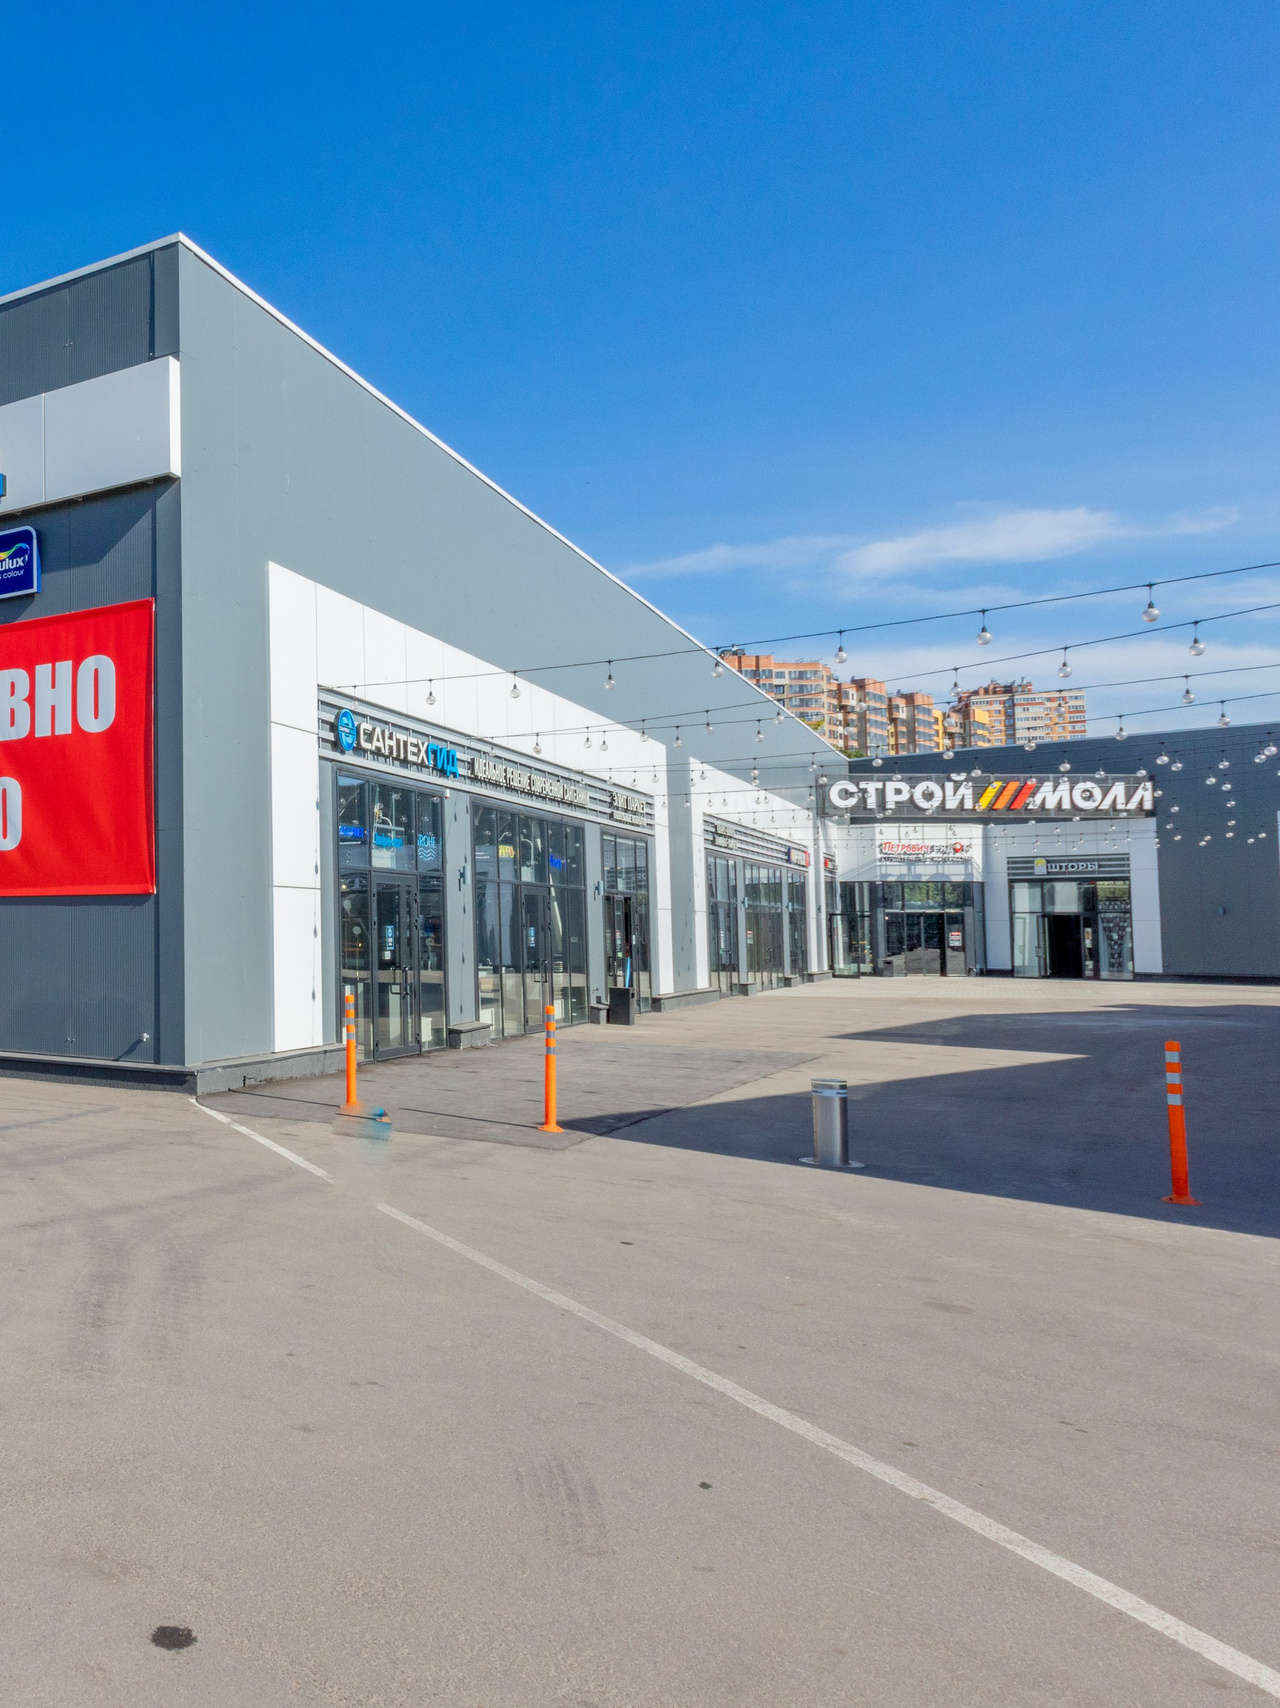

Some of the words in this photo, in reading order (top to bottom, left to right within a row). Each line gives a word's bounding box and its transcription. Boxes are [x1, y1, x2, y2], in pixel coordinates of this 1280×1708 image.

[3, 568, 25, 580] colour
[359, 722, 460, 779] САНТЕХГИД
[829, 772, 974, 810] СТРОЙ
[1027, 781, 1154, 810] МОЛЛ
[1047, 861, 1099, 871] ШТОРЫ
